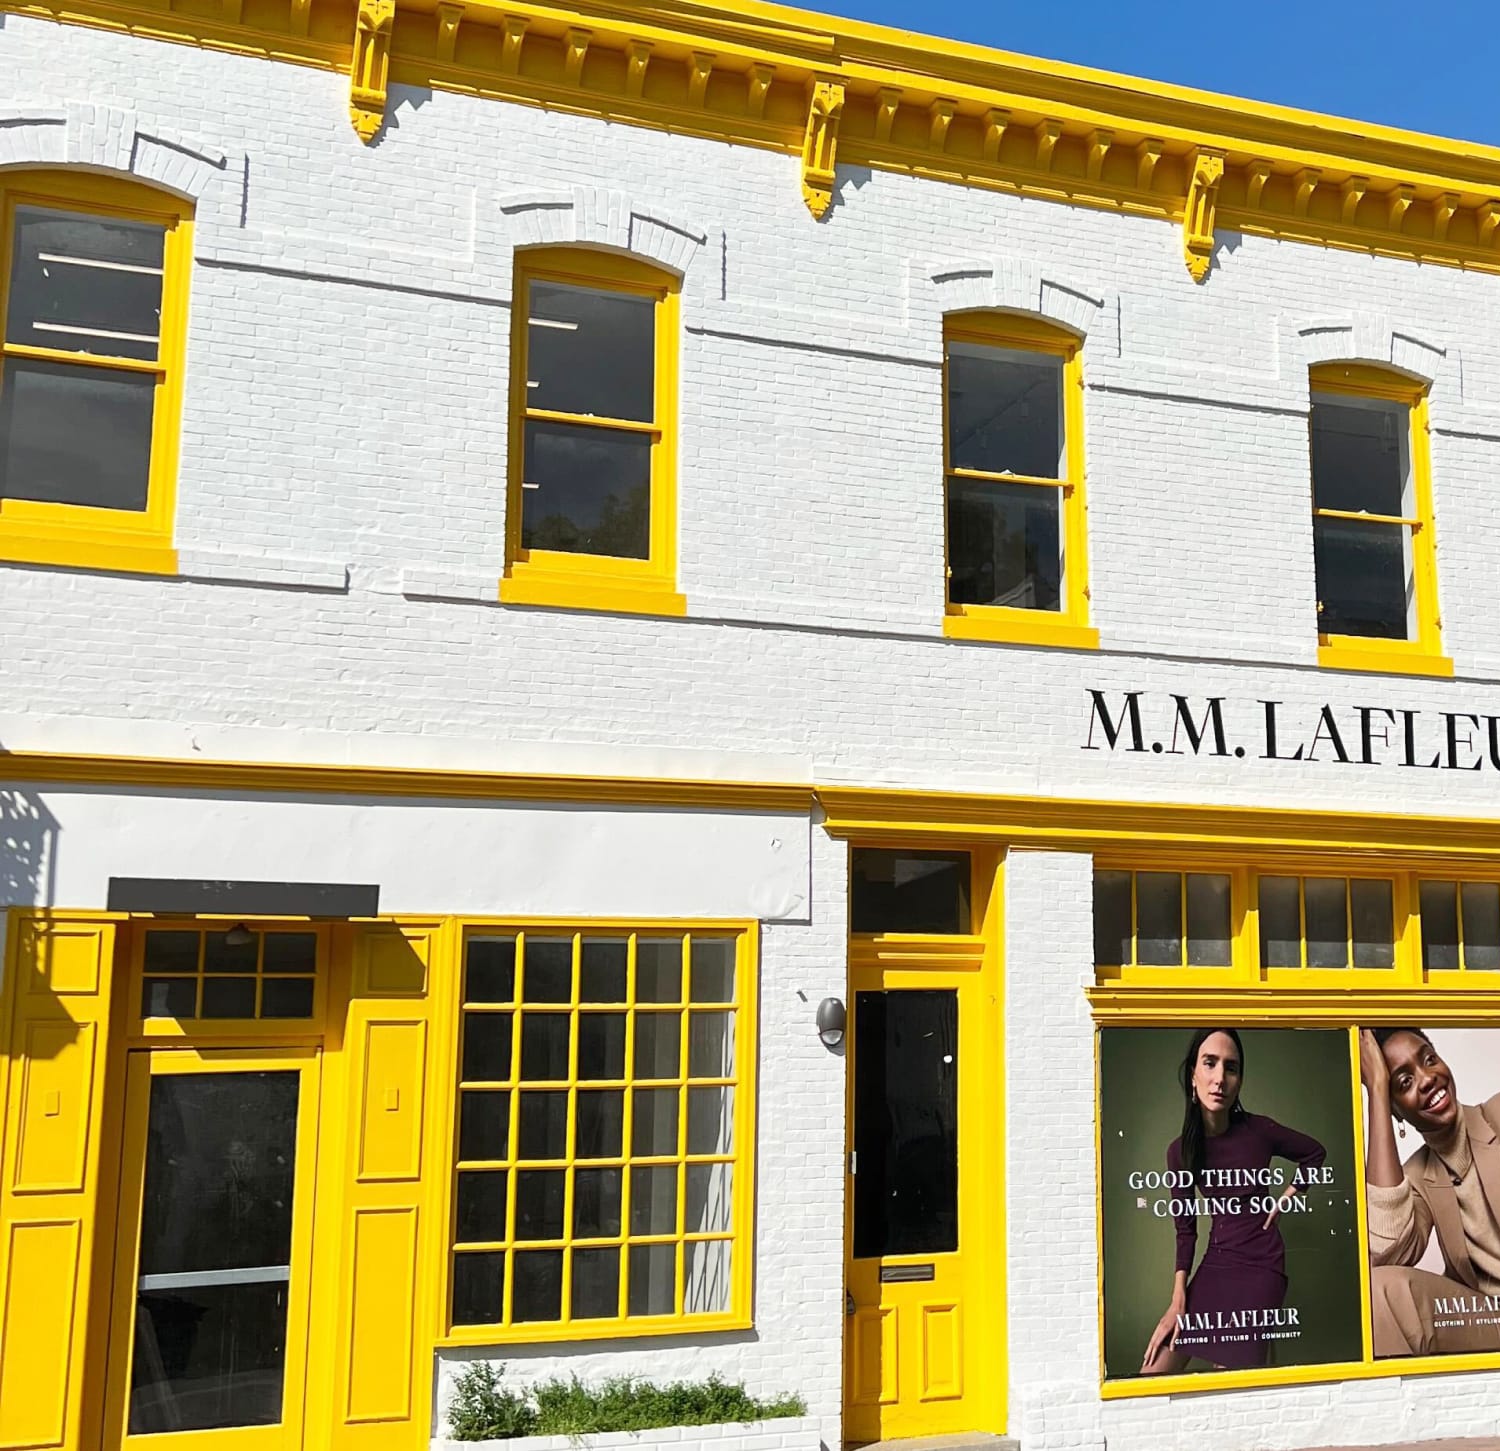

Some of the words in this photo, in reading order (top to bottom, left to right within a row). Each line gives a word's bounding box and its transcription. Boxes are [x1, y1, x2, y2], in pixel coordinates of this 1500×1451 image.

[1081, 689, 1246, 758] M.M.
[1128, 1170, 1194, 1190] GOOD
[1201, 1168, 1285, 1188] THINGS
[1292, 1166, 1335, 1186] ARE
[1153, 1198, 1242, 1217] COMING
[1249, 1195, 1313, 1215] SOON.
[1434, 1297, 1470, 1314] M.M.
[1176, 1312, 1215, 1331] M.M.
[1215, 1307, 1300, 1329] LAFLEUR
[1175, 1336, 1209, 1345] CLOTHING
[1261, 1331, 1302, 1340] COMMUNITY
